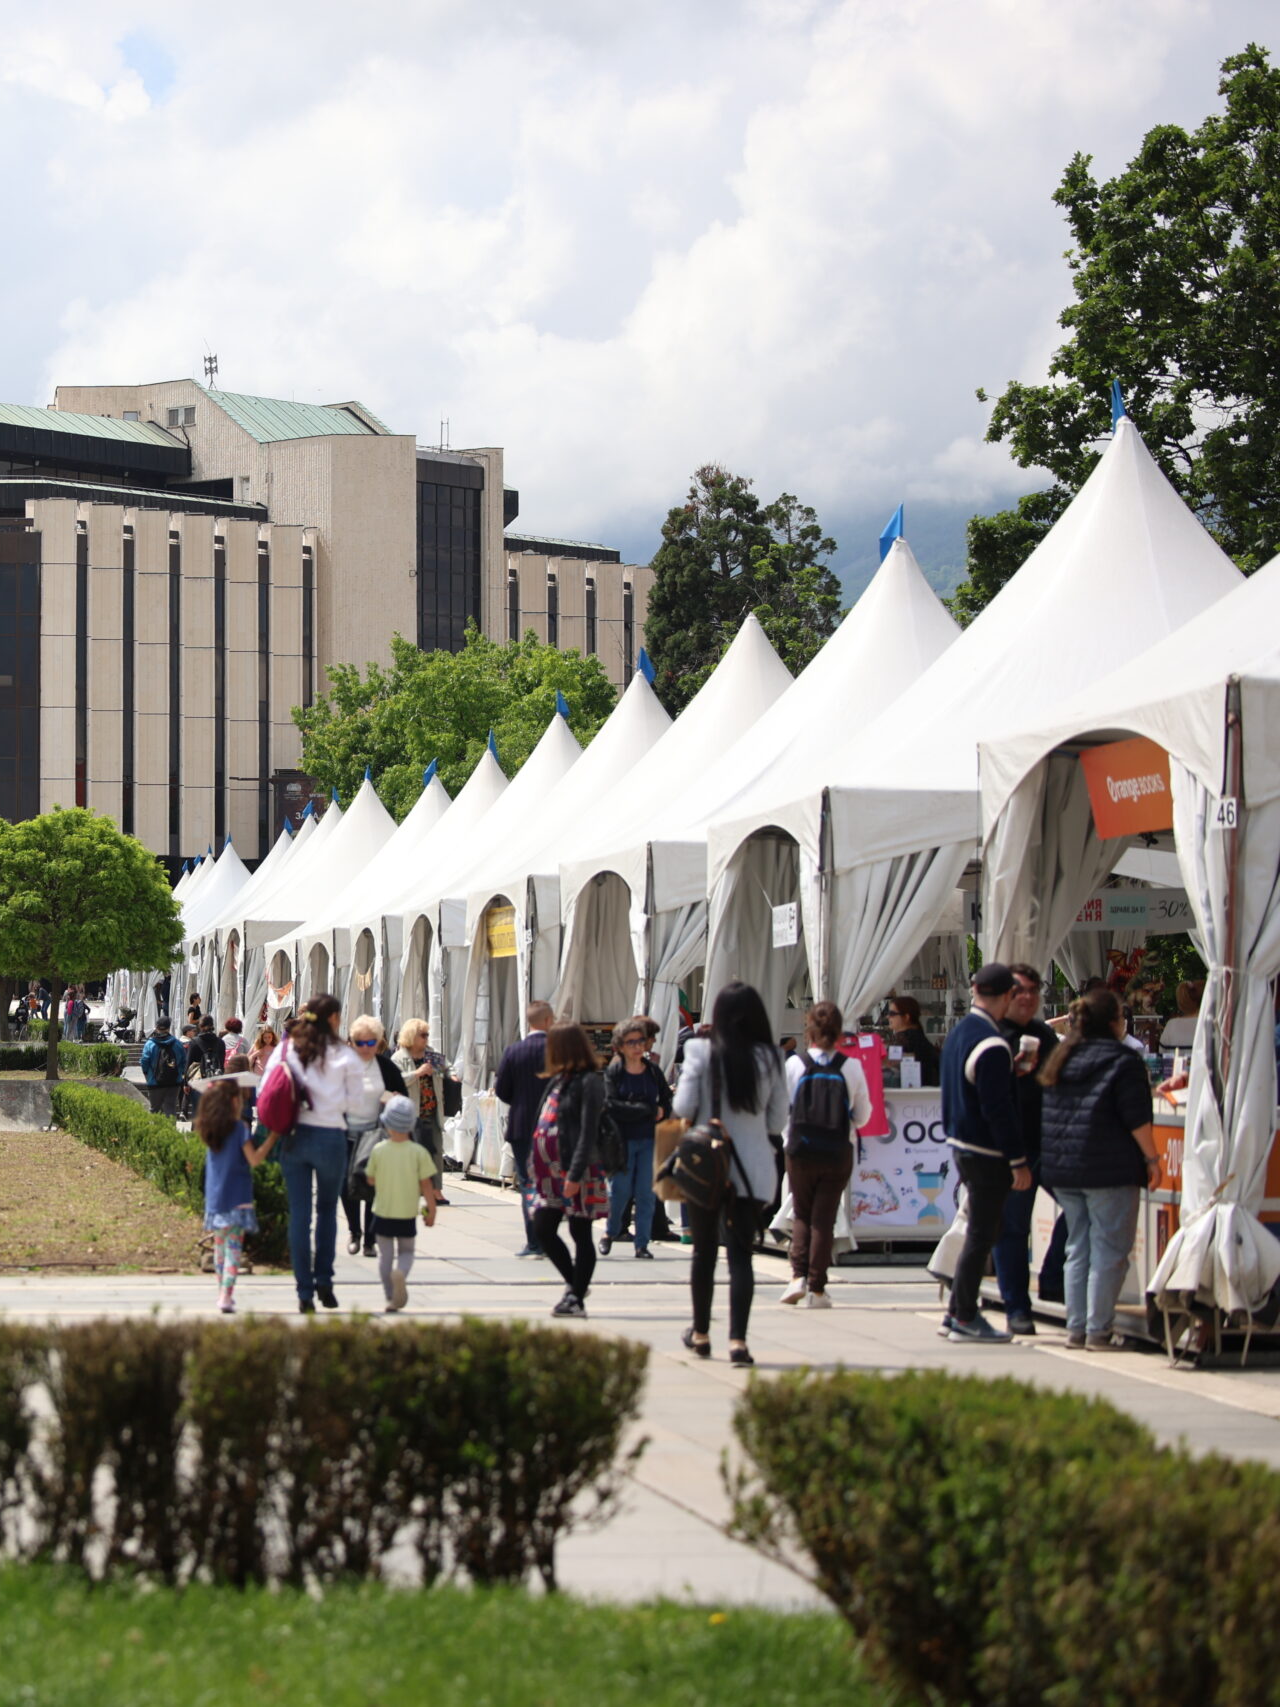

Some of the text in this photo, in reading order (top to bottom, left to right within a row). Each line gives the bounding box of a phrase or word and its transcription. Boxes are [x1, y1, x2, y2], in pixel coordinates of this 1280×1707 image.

[295, 811, 318, 820] ЗА
[1217, 801, 1236, 826] 46
[1149, 899, 1188, 919] -30%
[902, 1104, 943, 1119] СПИС
[903, 1120, 947, 1145] ОС
